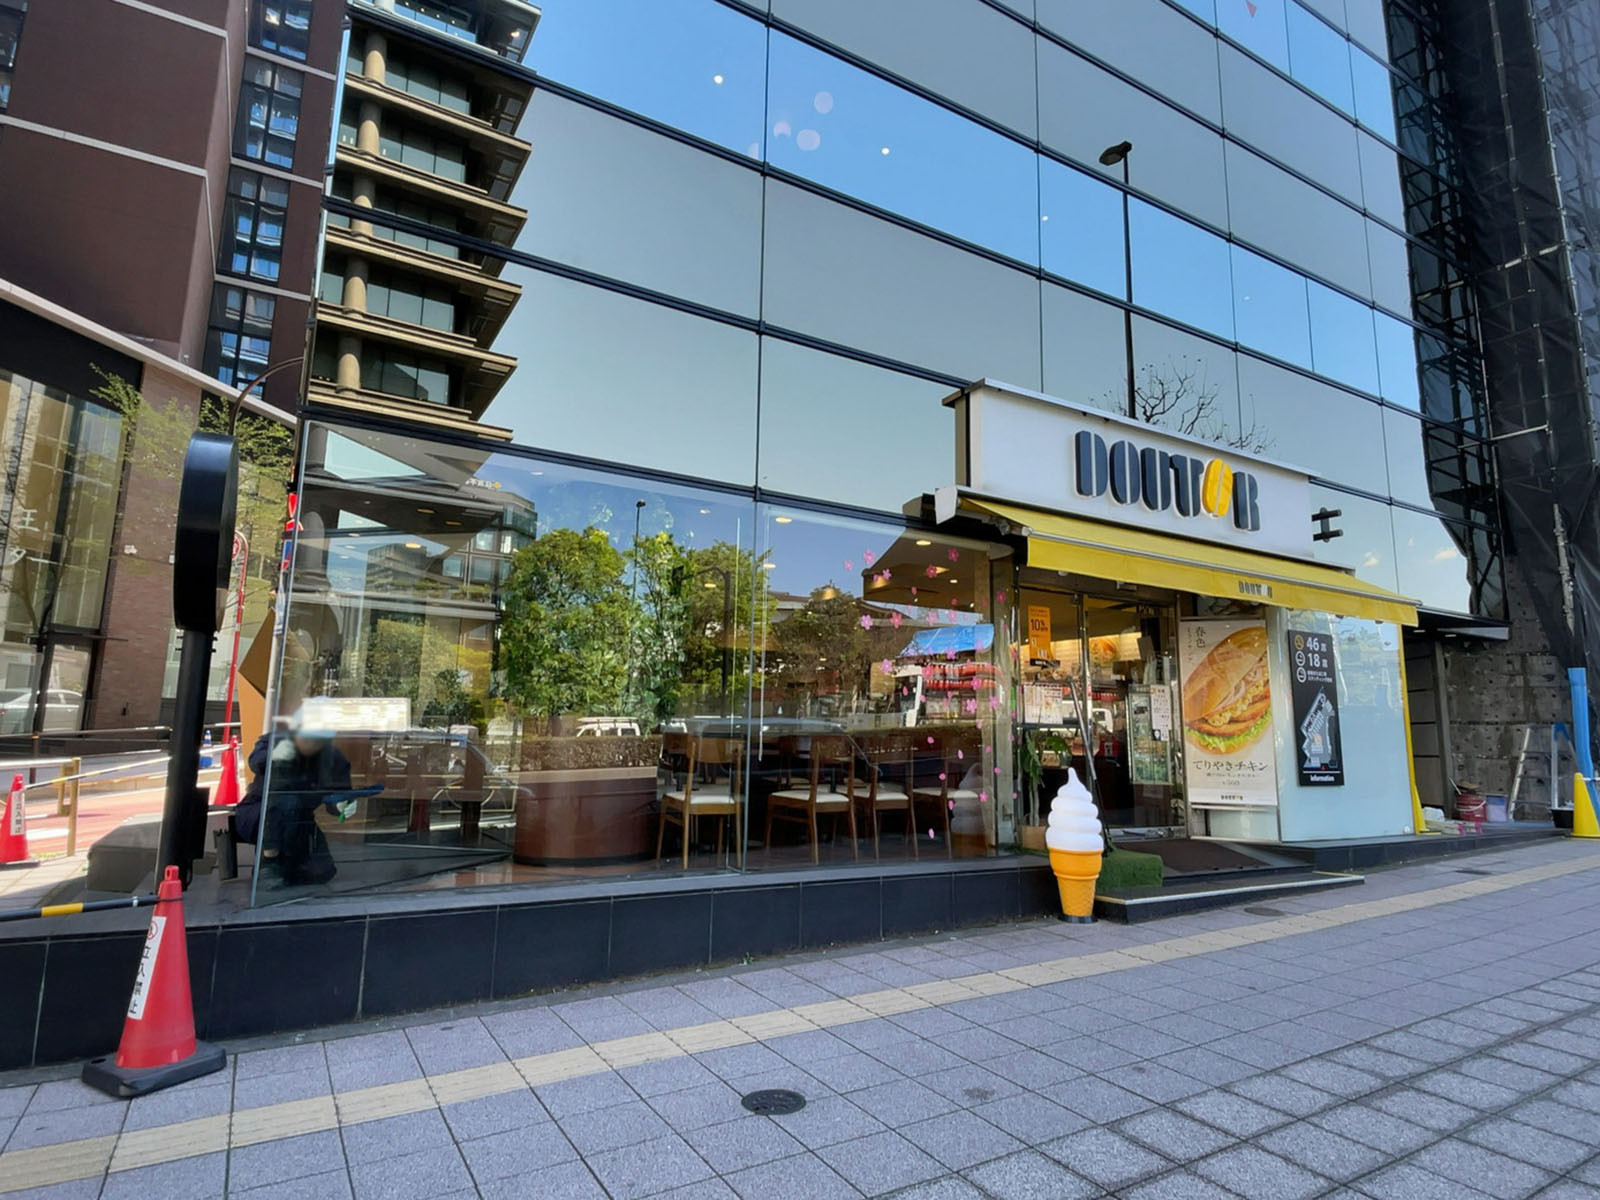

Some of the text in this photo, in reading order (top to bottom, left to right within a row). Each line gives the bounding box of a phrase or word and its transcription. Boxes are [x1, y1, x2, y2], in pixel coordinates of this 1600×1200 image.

[1075, 430, 1261, 531] DOUTOR
[1193, 760, 1268, 771] てりやきチキン
